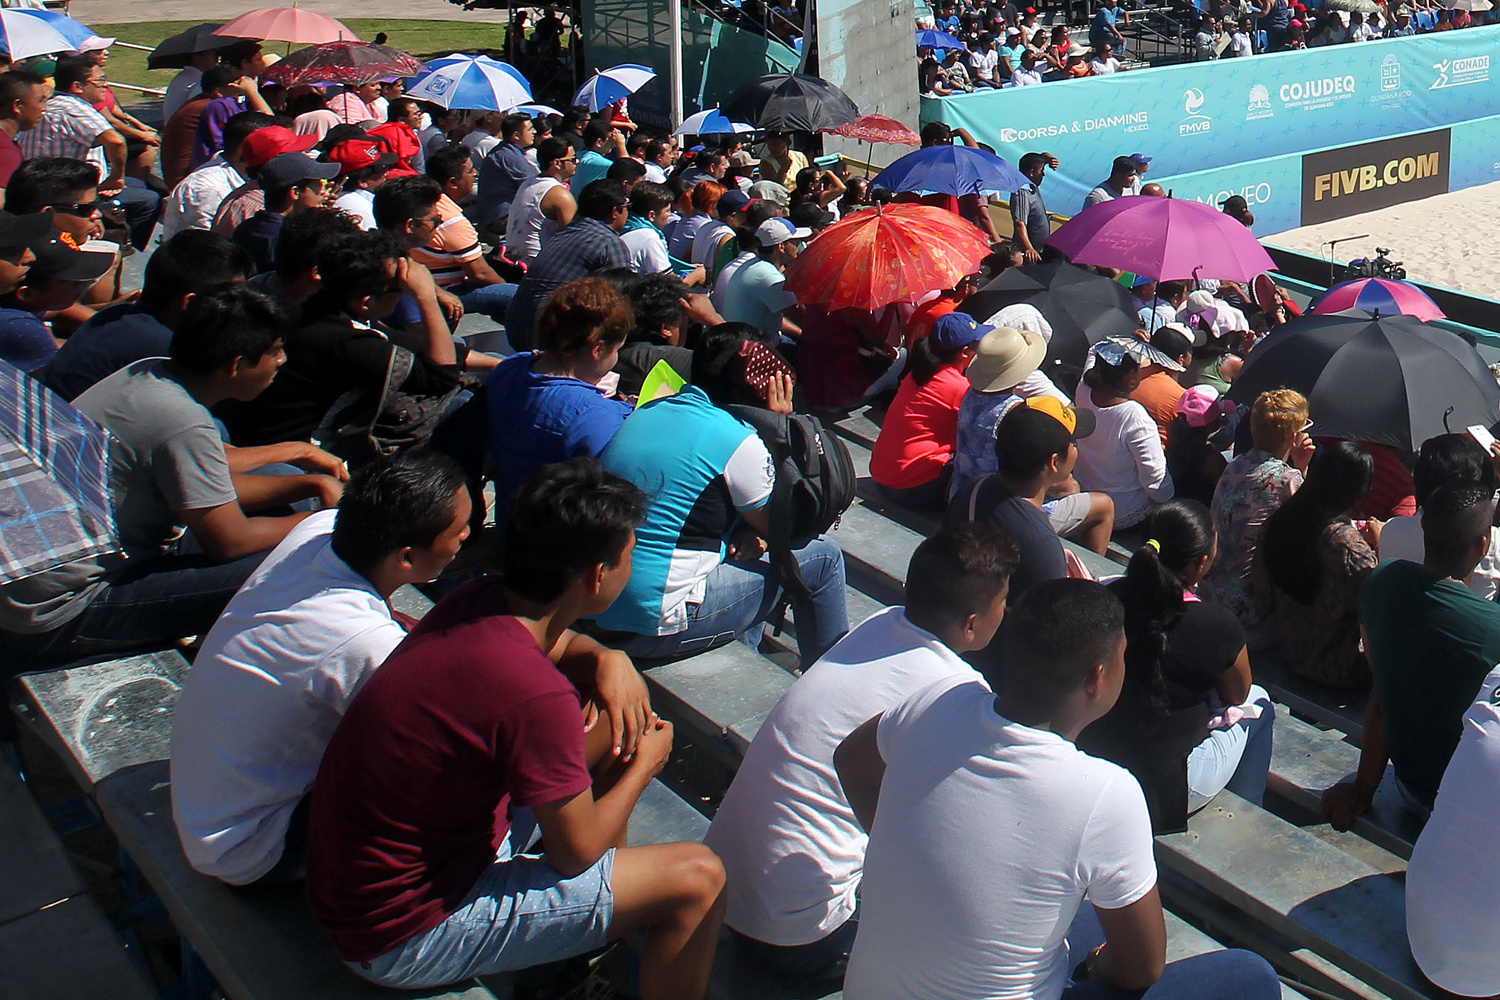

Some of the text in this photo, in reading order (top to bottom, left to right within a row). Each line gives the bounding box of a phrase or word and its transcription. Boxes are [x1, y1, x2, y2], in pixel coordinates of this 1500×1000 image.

[1453, 57, 1490, 72] CONADE
[1279, 75, 1357, 102] COJUDEQ
[1071, 119, 1082, 133] &
[1084, 111, 1149, 132] DIANMING
[1178, 121, 1211, 135] FMVB
[1314, 151, 1440, 202] FIVB.COM
